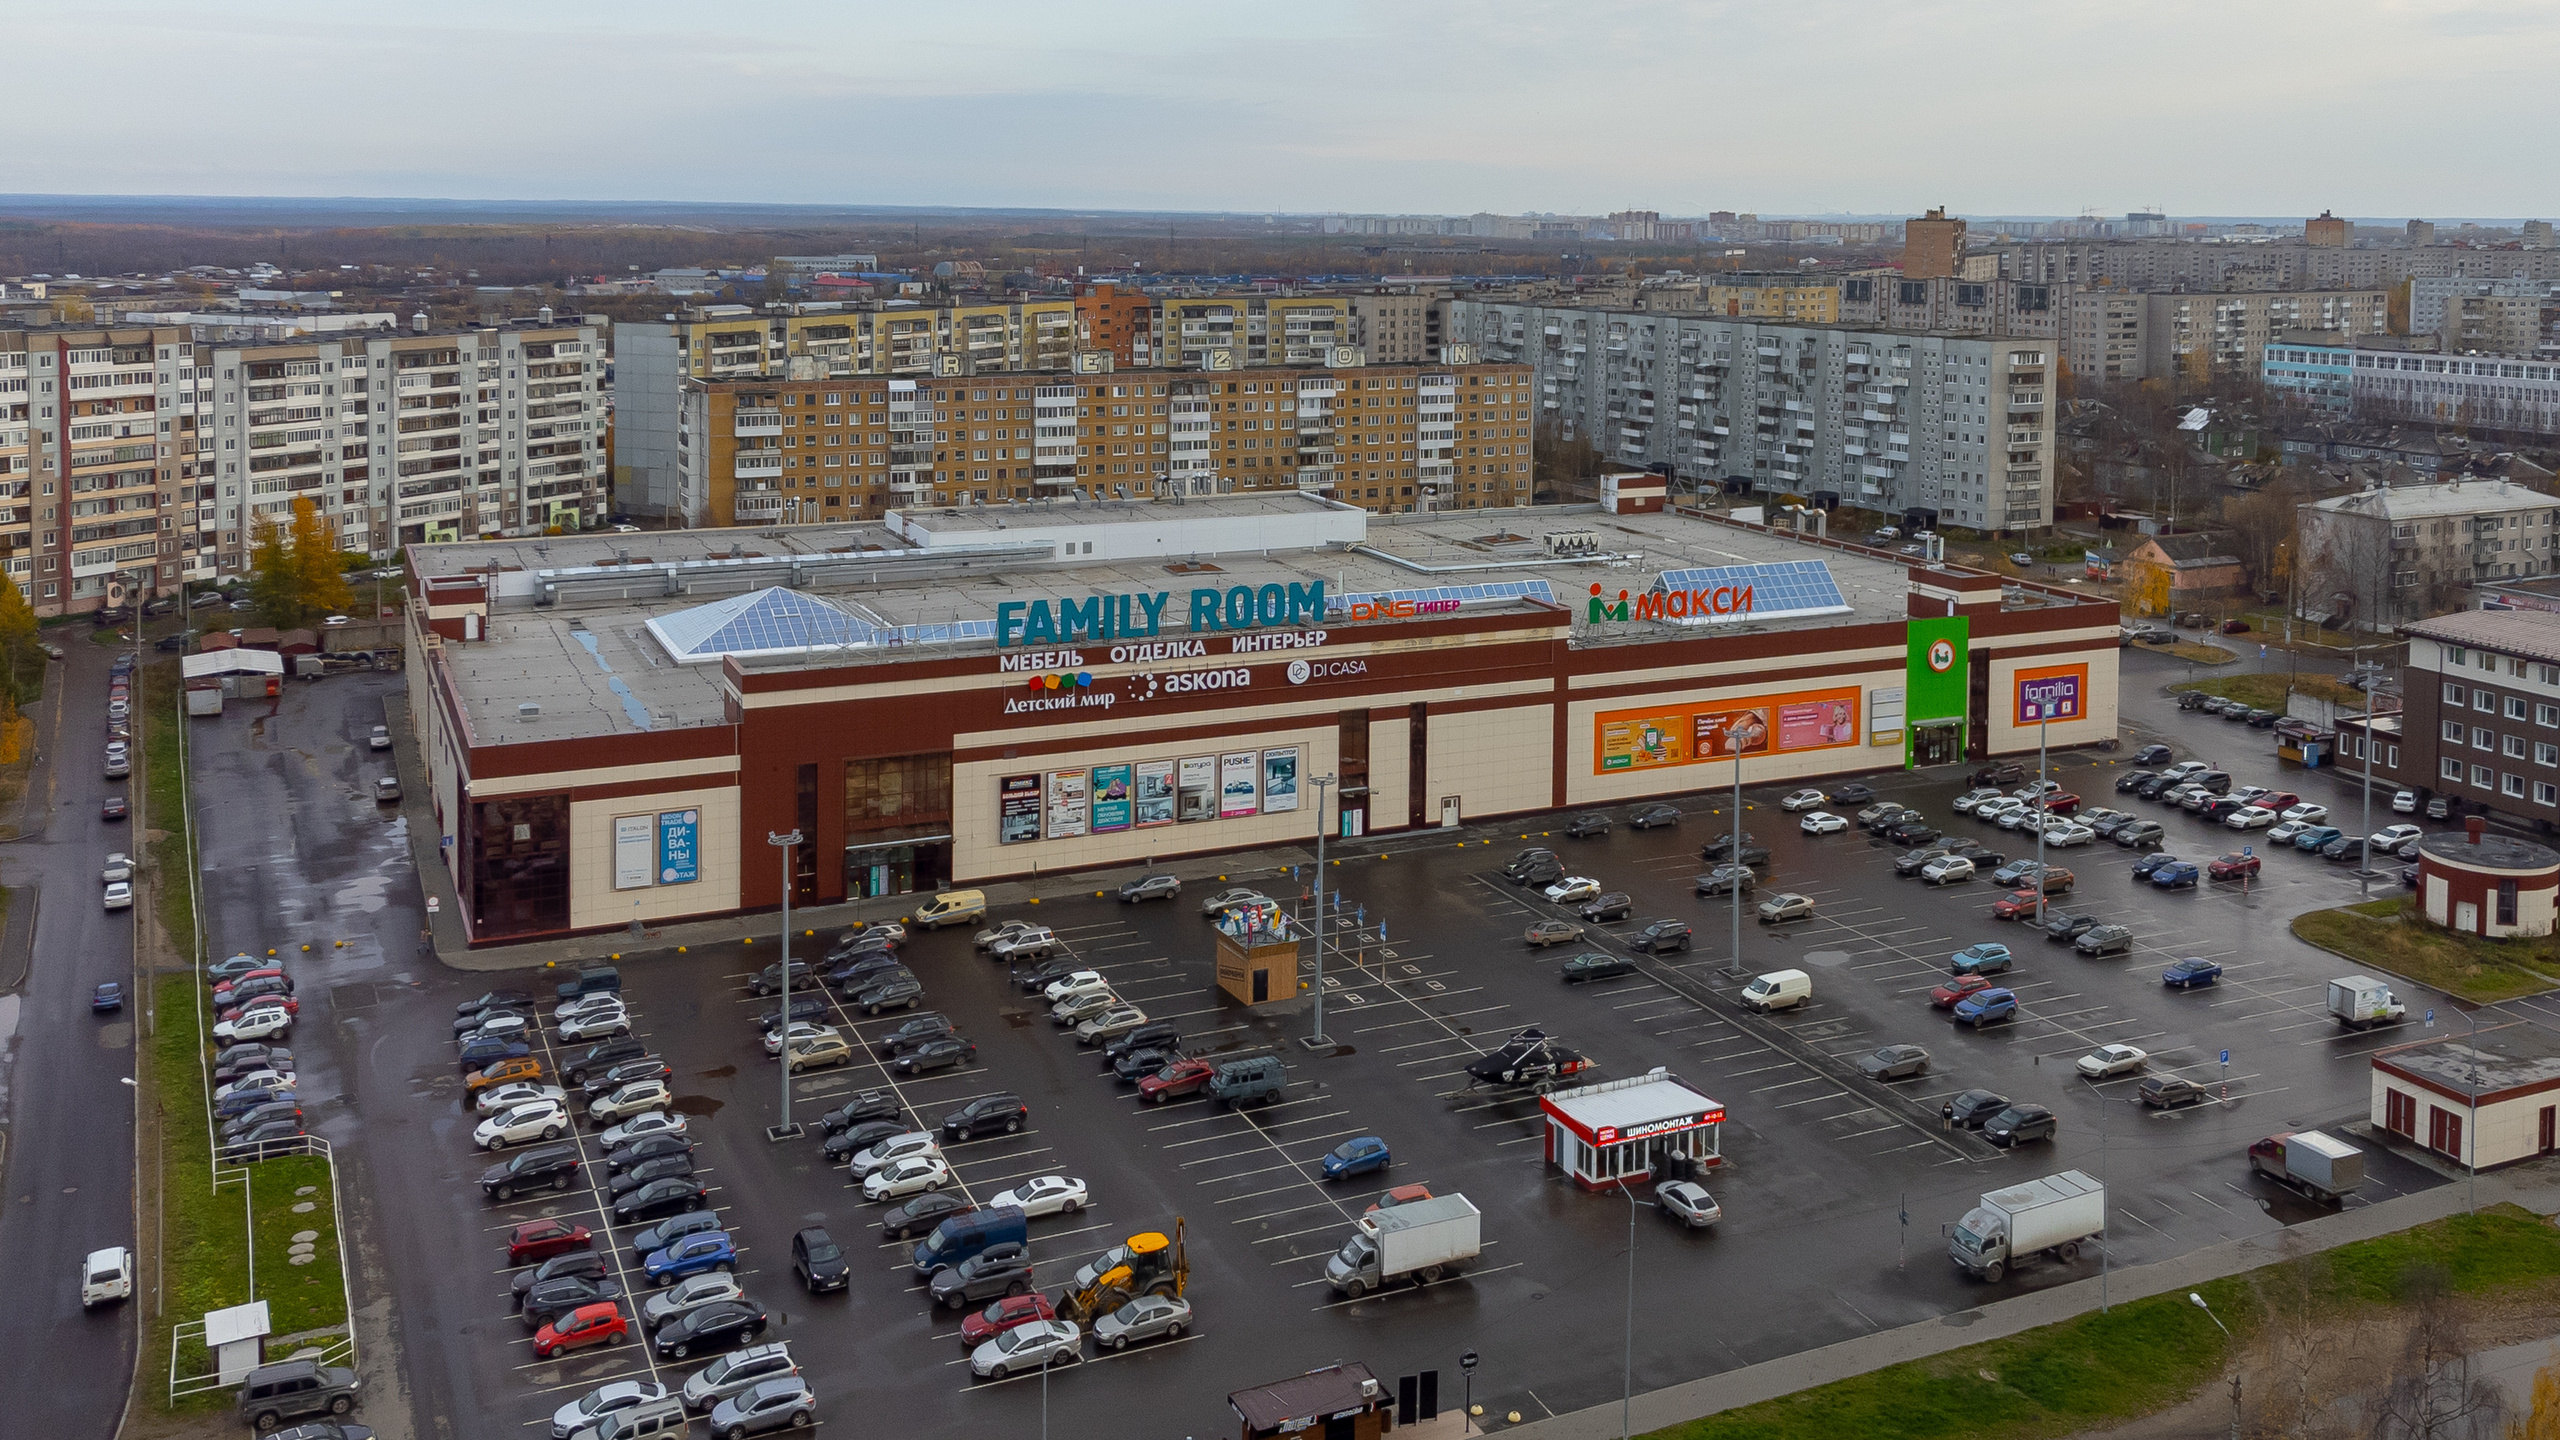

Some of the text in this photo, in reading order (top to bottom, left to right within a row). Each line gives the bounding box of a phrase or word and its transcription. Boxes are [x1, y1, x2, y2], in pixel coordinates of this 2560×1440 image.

[942, 353, 960, 375] R
[1082, 353, 1099, 371] E
[1213, 350, 1231, 368] Z
[1453, 345, 1467, 363] N
[998, 580, 1324, 647] FAMILY ROOM
[1351, 600, 1460, 621] DNS ГИПЕР
[1000, 630, 1327, 672] МЕБЕЛЬ ОТДЕЛКА ИНТЕРЬЕР
[1313, 663, 1327, 677] DI
[1330, 660, 1367, 676] CASA
[1165, 668, 1250, 692] askona
[2024, 681, 2074, 700] familia
[1004, 692, 1115, 714] Детский мир
[1223, 756, 1250, 766] PUSHE
[661, 818, 683, 826] TRADE
[667, 826, 690, 839] ДИ-
[668, 838, 690, 849] ВА-
[668, 849, 690, 861] НЫ
[1626, 1115, 1693, 1137] ШИНОМОНТАЖ
